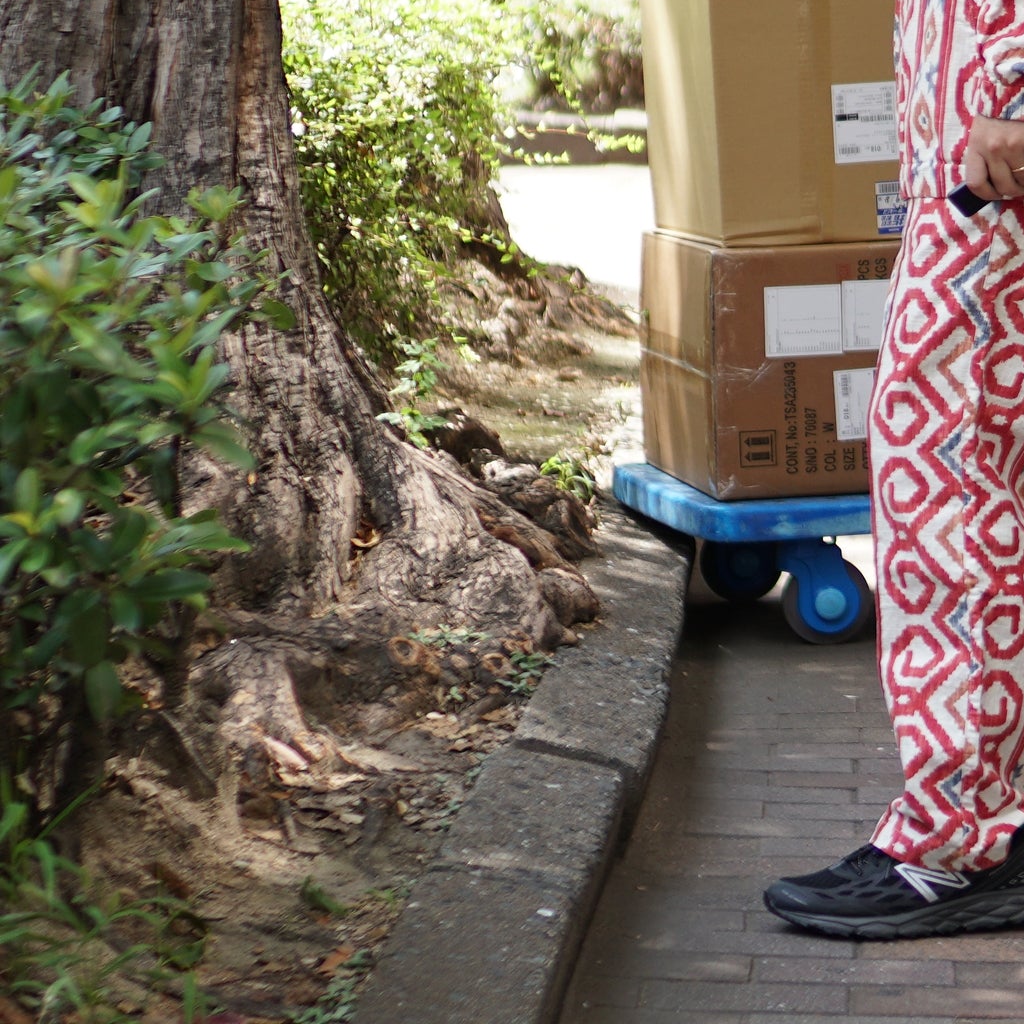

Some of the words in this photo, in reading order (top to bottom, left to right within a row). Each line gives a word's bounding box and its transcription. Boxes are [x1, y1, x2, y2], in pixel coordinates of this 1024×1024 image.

[822, 422, 834, 433] W
[824, 449, 837, 472] COL
[843, 448, 855, 471] SIZE
